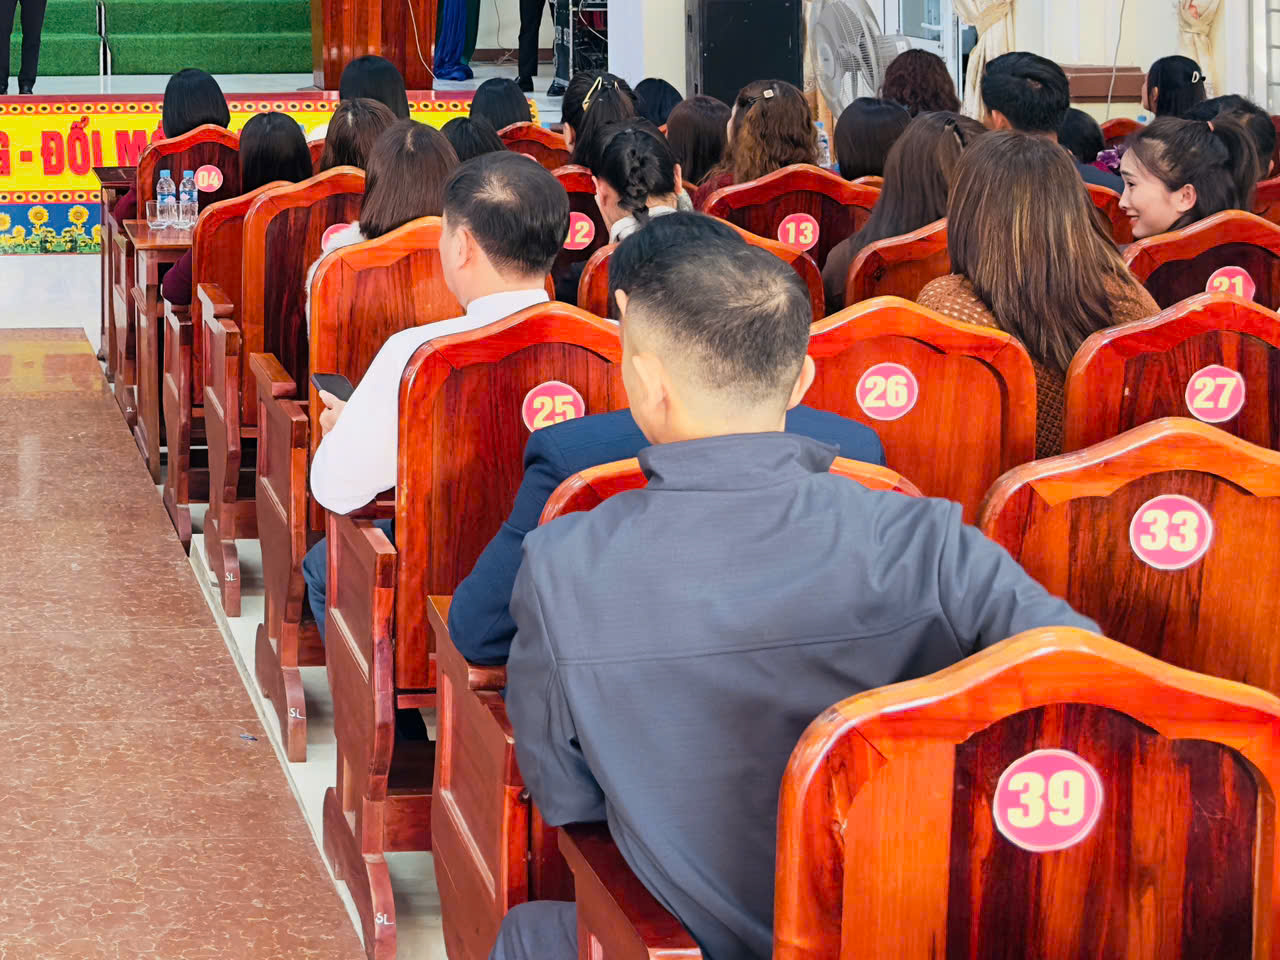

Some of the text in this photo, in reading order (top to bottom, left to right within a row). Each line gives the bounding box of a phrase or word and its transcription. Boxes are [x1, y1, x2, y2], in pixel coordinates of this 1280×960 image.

[40, 115, 104, 176] ĐỔI
[198, 171, 218, 188] 04
[786, 222, 814, 244] 13
[862, 375, 908, 408] 26
[1193, 377, 1239, 409] 27
[533, 395, 576, 428] 25
[1140, 509, 1198, 552] 33
[1006, 768, 1082, 828] 39
